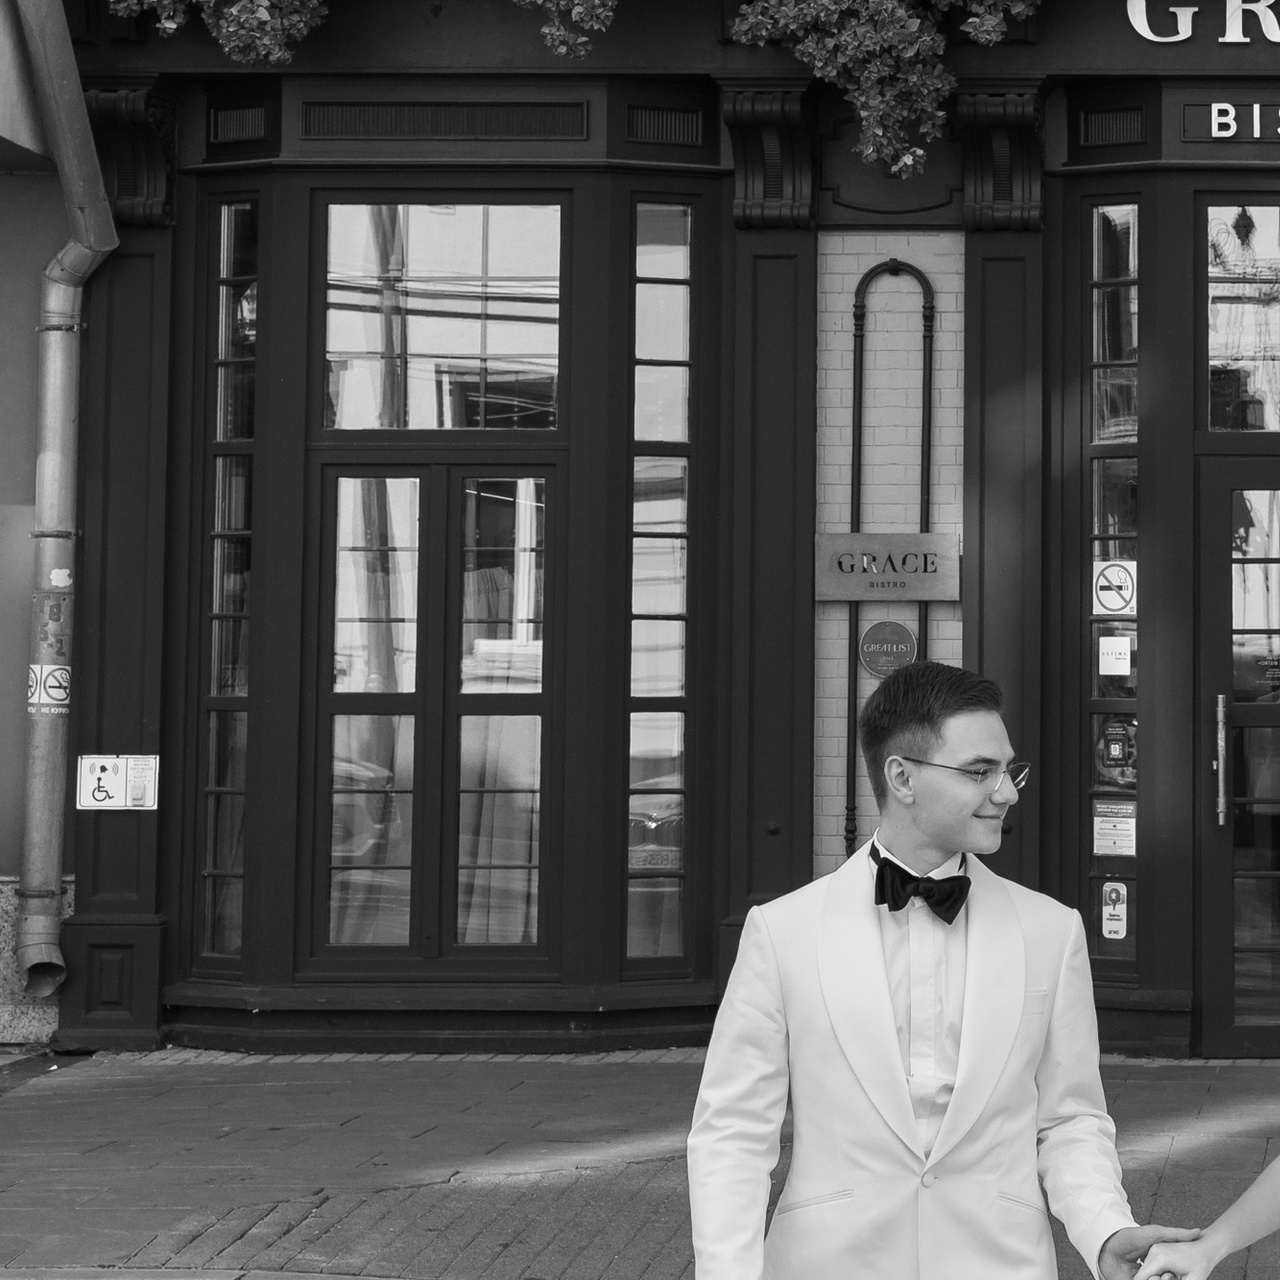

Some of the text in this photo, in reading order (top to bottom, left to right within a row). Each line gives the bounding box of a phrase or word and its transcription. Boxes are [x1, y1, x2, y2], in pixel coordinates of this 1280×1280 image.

[837, 553, 938, 573] GRACE
[869, 581, 907, 589] BISTRO
[863, 643, 911, 652] GREAT LIST
